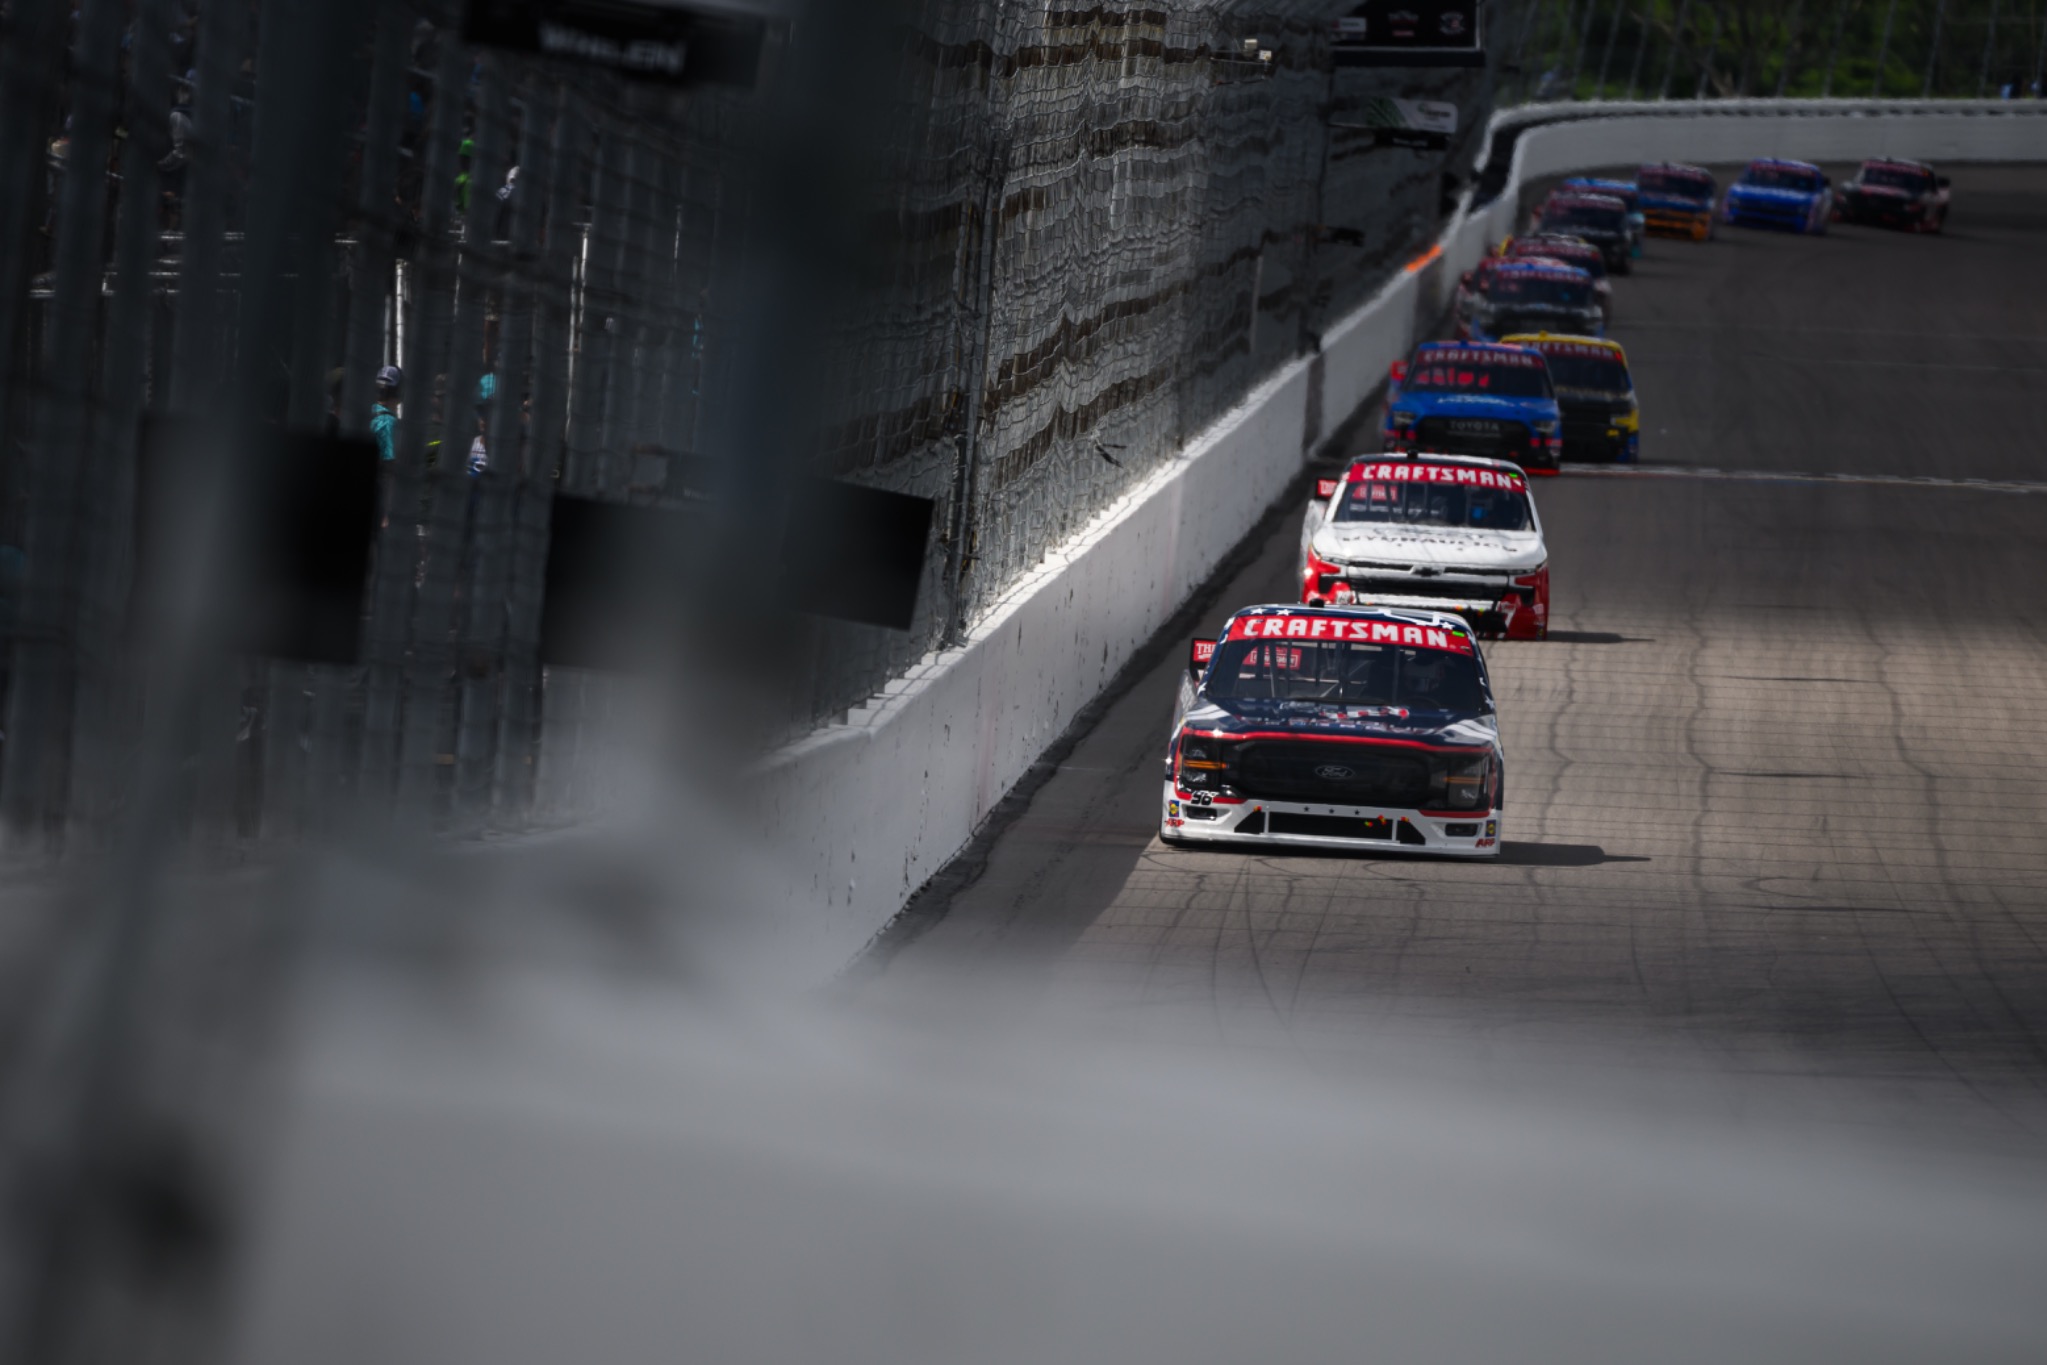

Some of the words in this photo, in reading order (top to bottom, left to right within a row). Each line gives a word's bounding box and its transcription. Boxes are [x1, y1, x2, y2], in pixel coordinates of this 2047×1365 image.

[1424, 350, 1534, 367] CRAFTSMAN
[1449, 420, 1500, 432] TOYOTA
[1362, 465, 1512, 489] CRAFTSMAN
[1243, 617, 1449, 648] CRAFTSMAN
[1319, 766, 1350, 778] Ford
[1475, 838, 1495, 848] ARP
